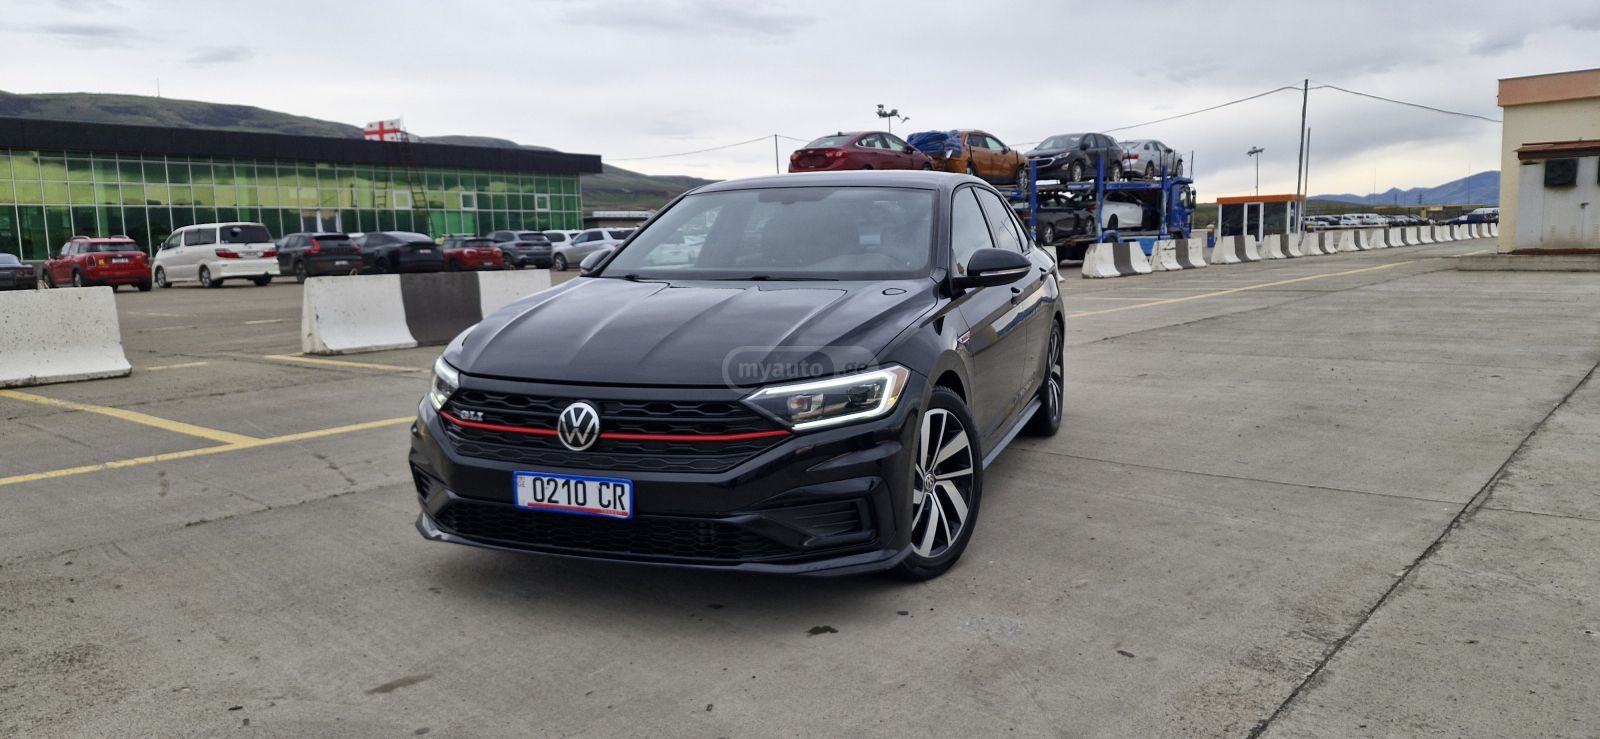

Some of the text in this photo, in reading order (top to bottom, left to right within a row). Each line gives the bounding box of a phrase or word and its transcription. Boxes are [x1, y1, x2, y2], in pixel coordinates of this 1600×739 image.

[460, 409, 484, 421] GLI
[532, 477, 626, 511] 0210 CR
